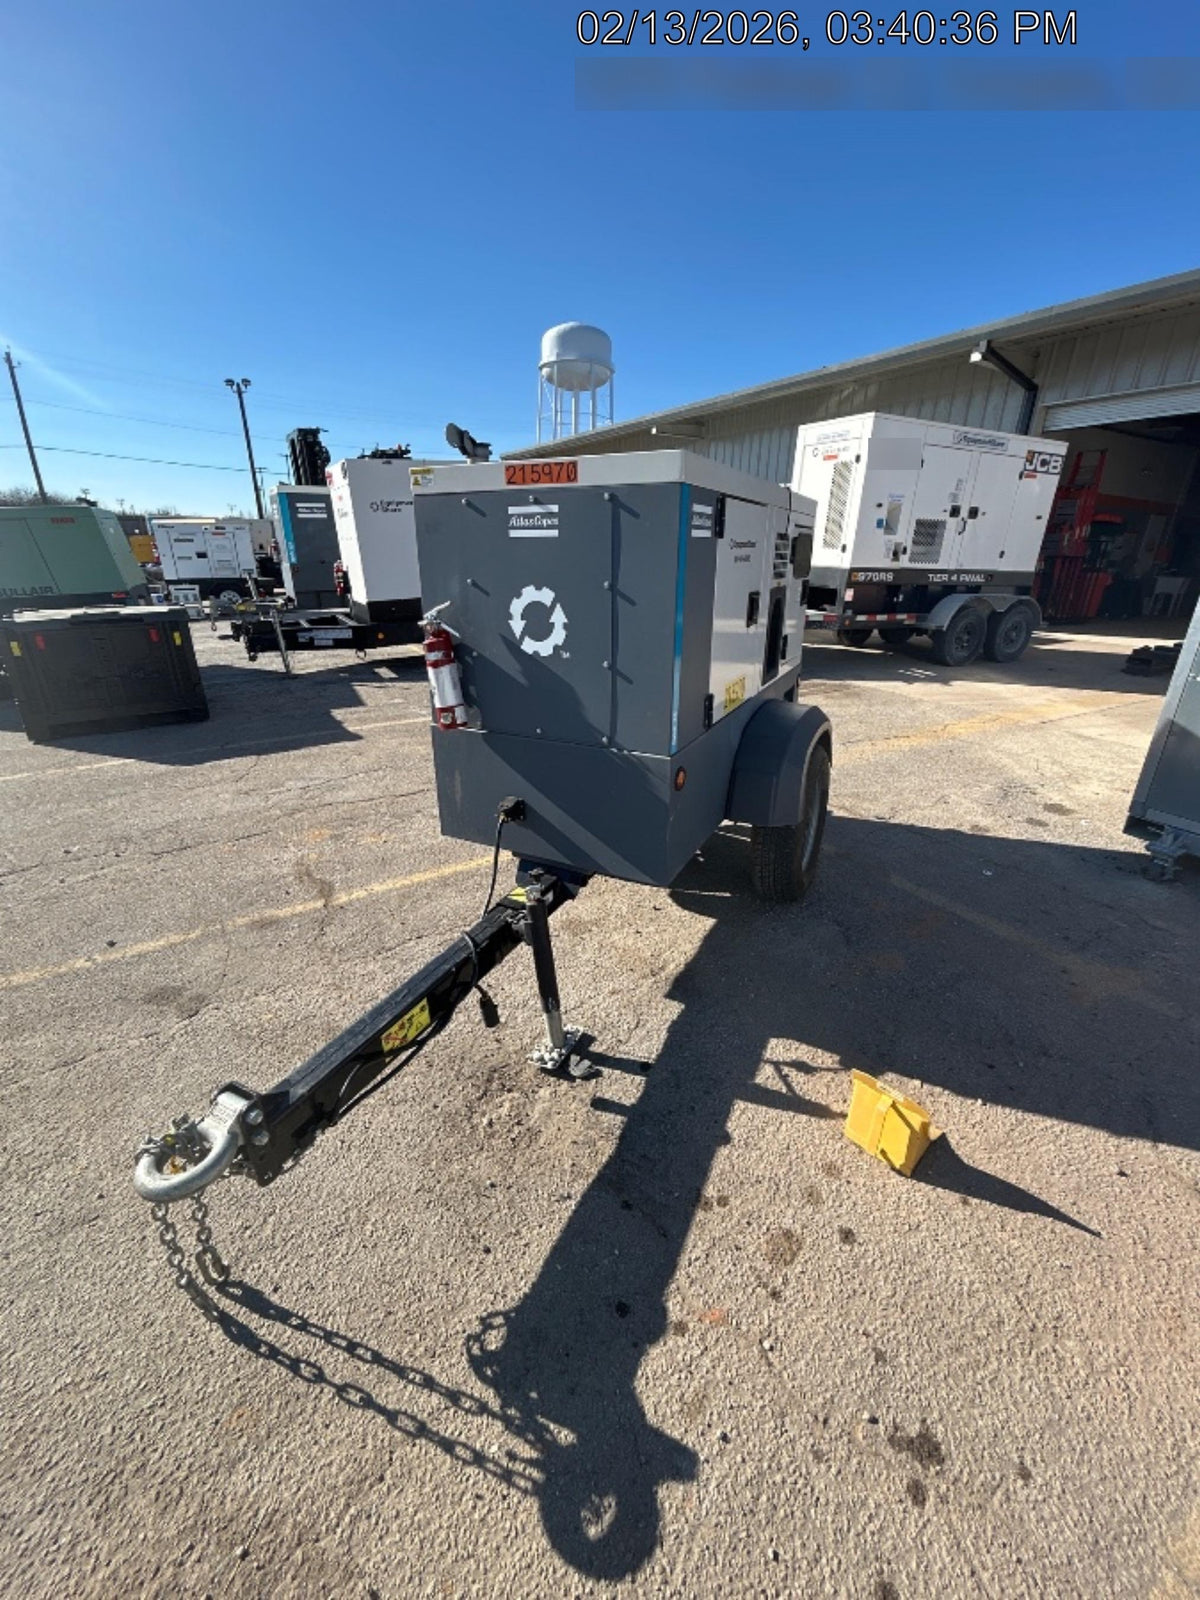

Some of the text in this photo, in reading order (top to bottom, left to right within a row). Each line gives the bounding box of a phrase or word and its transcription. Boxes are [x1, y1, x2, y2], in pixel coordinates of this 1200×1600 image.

[506, 461, 578, 485] 215970
[1026, 451, 1063, 474] JCB
[927, 573, 948, 582] TIER
[950, 574, 958, 582] 4
